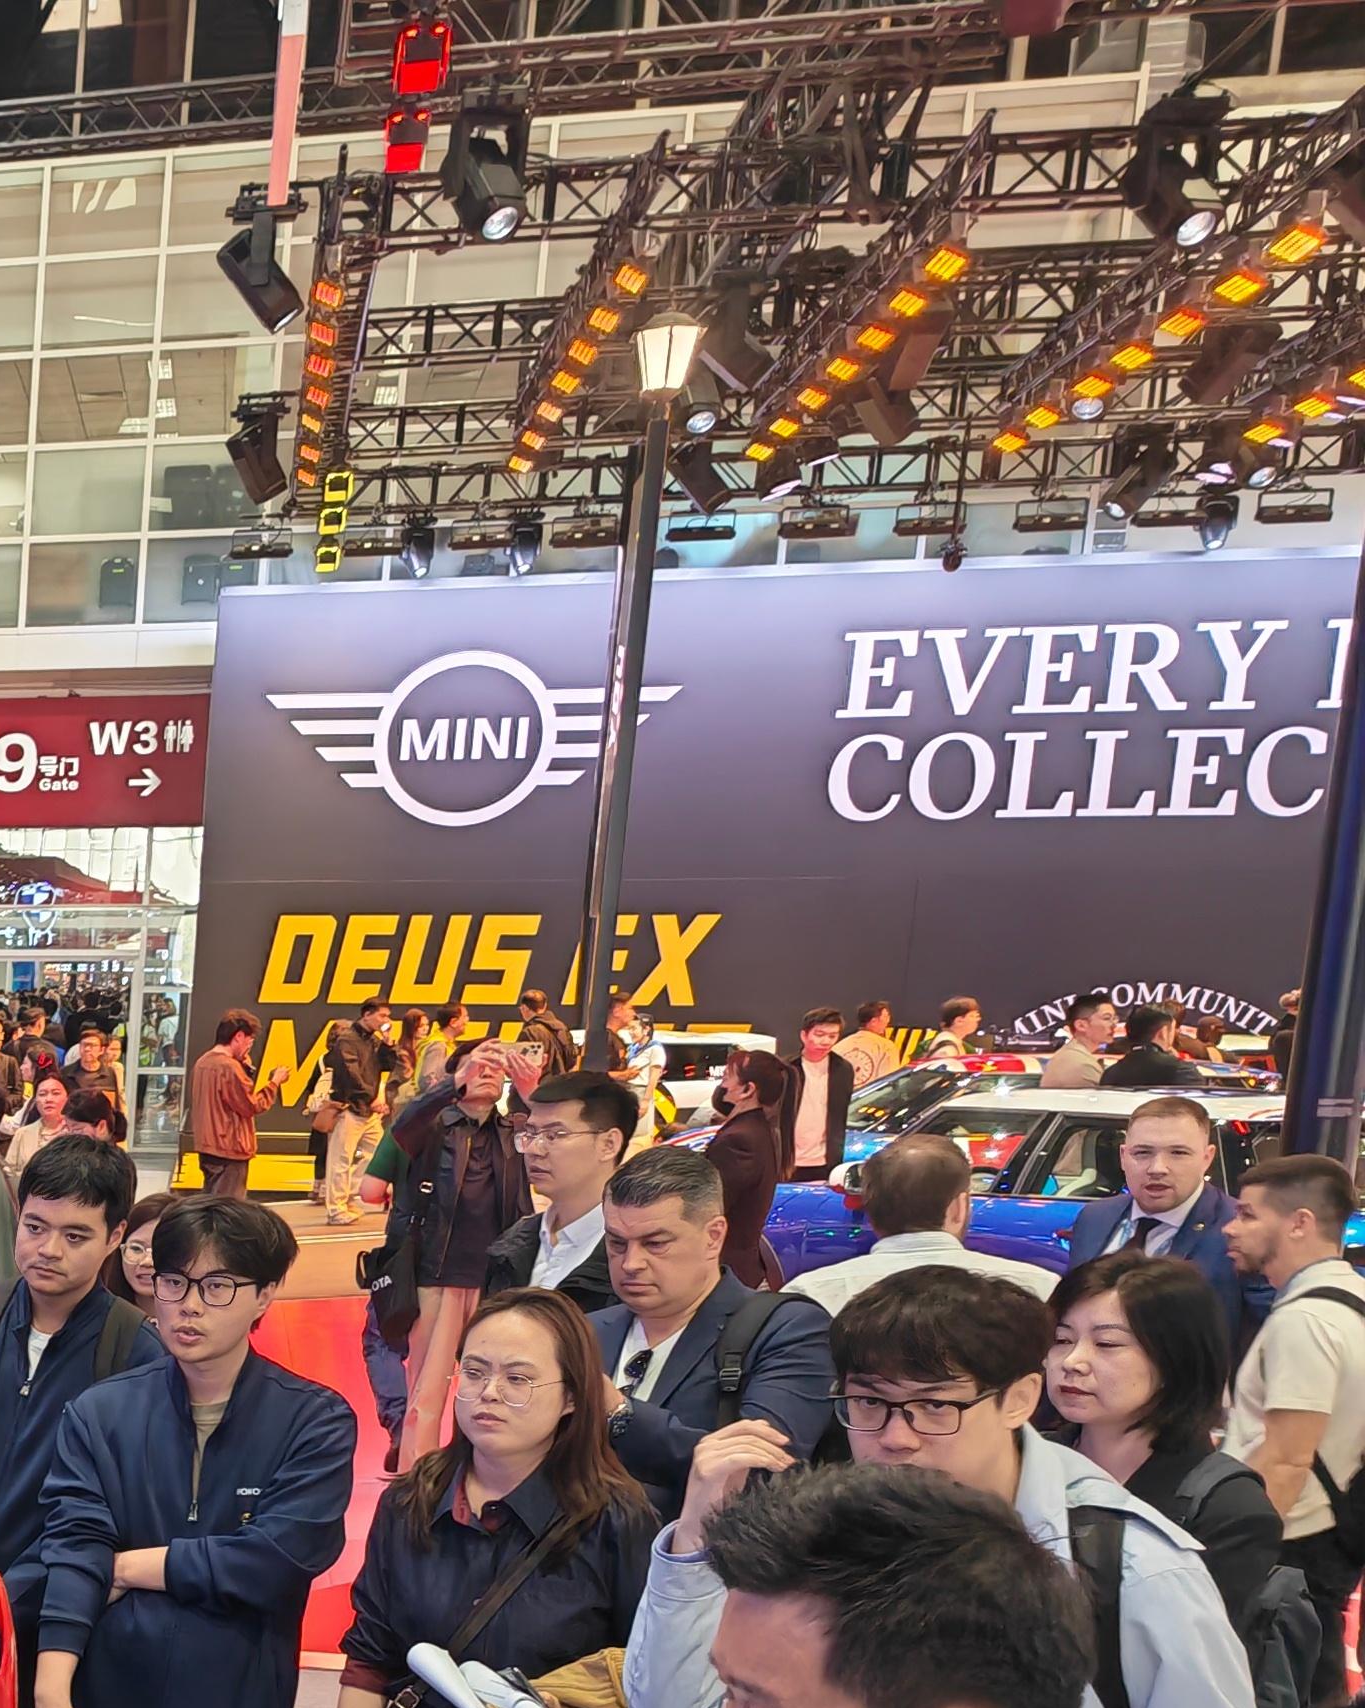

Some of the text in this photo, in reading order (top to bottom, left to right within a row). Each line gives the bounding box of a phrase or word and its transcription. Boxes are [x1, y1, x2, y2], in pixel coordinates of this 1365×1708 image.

[835, 619, 1288, 719] EVERY
[89, 720, 158, 756] W3
[399, 716, 531, 761] MINI
[38, 778, 80, 792] Gate
[828, 726, 1327, 822] COLLEC
[258, 914, 543, 1005] DEUS
[1091, 982, 1279, 1037] OMMUNIT
